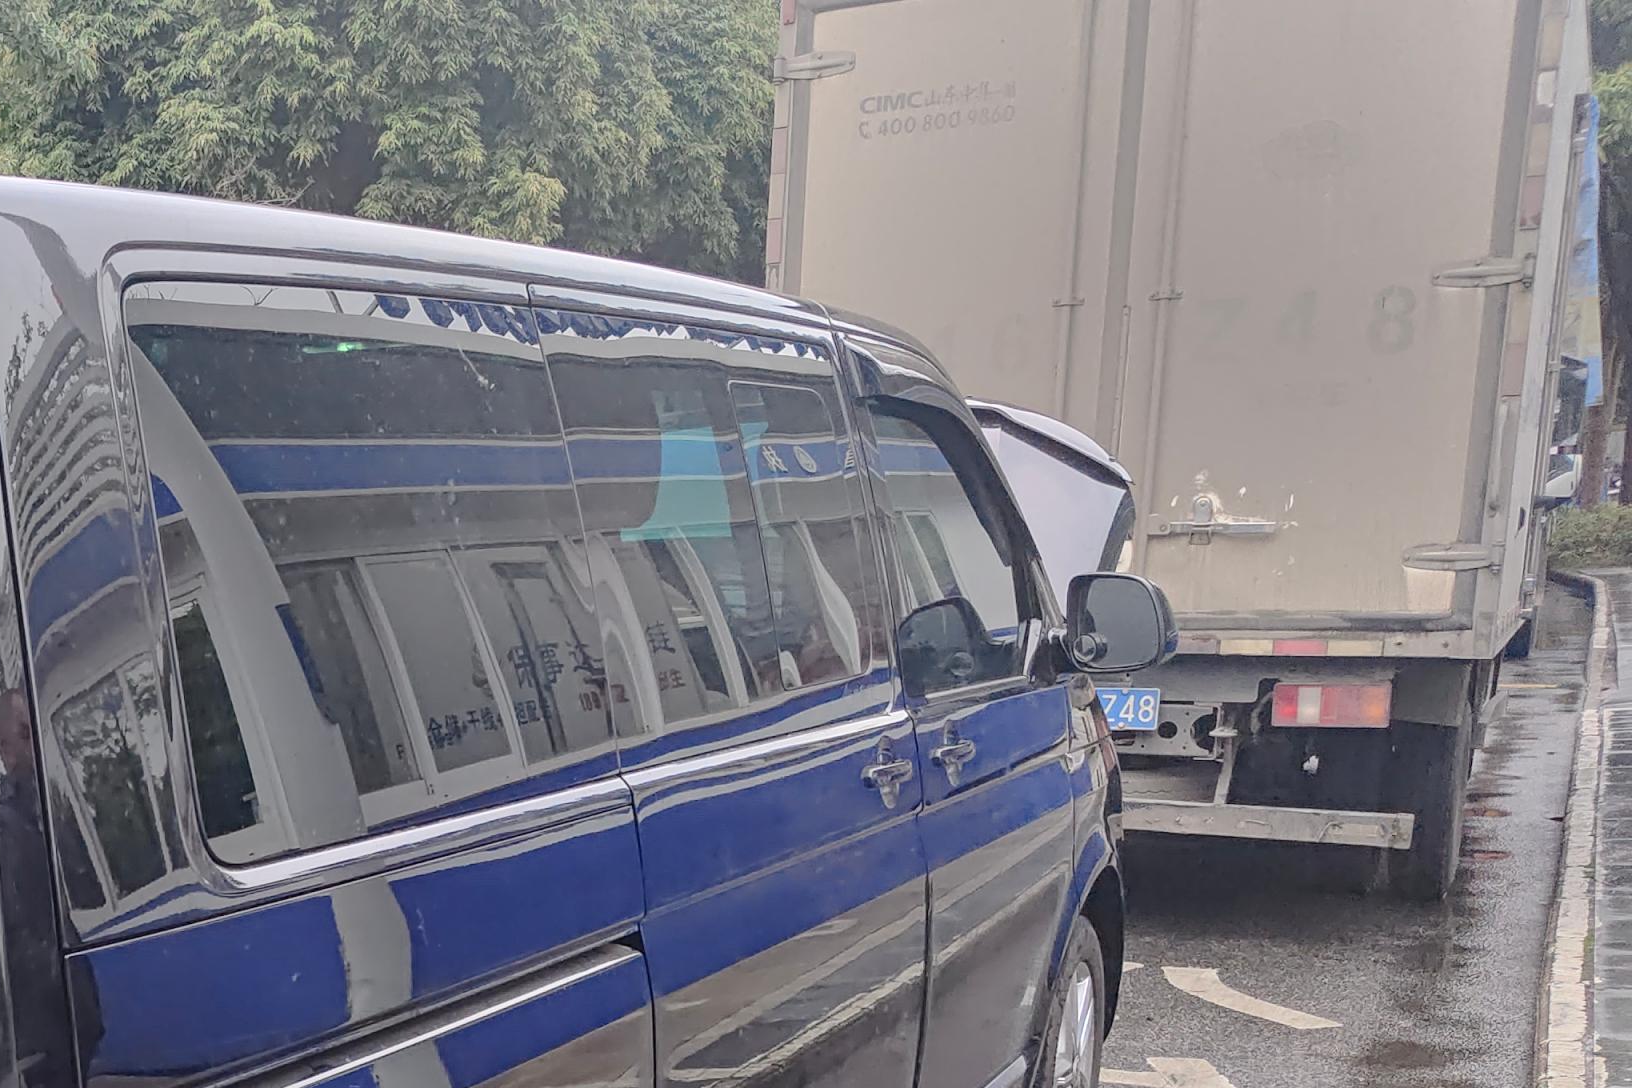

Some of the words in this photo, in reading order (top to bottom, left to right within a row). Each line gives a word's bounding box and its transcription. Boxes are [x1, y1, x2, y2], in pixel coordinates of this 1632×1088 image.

[859, 91, 923, 114] CIMC
[878, 116, 916, 136] 400
[922, 110, 961, 132] 800
